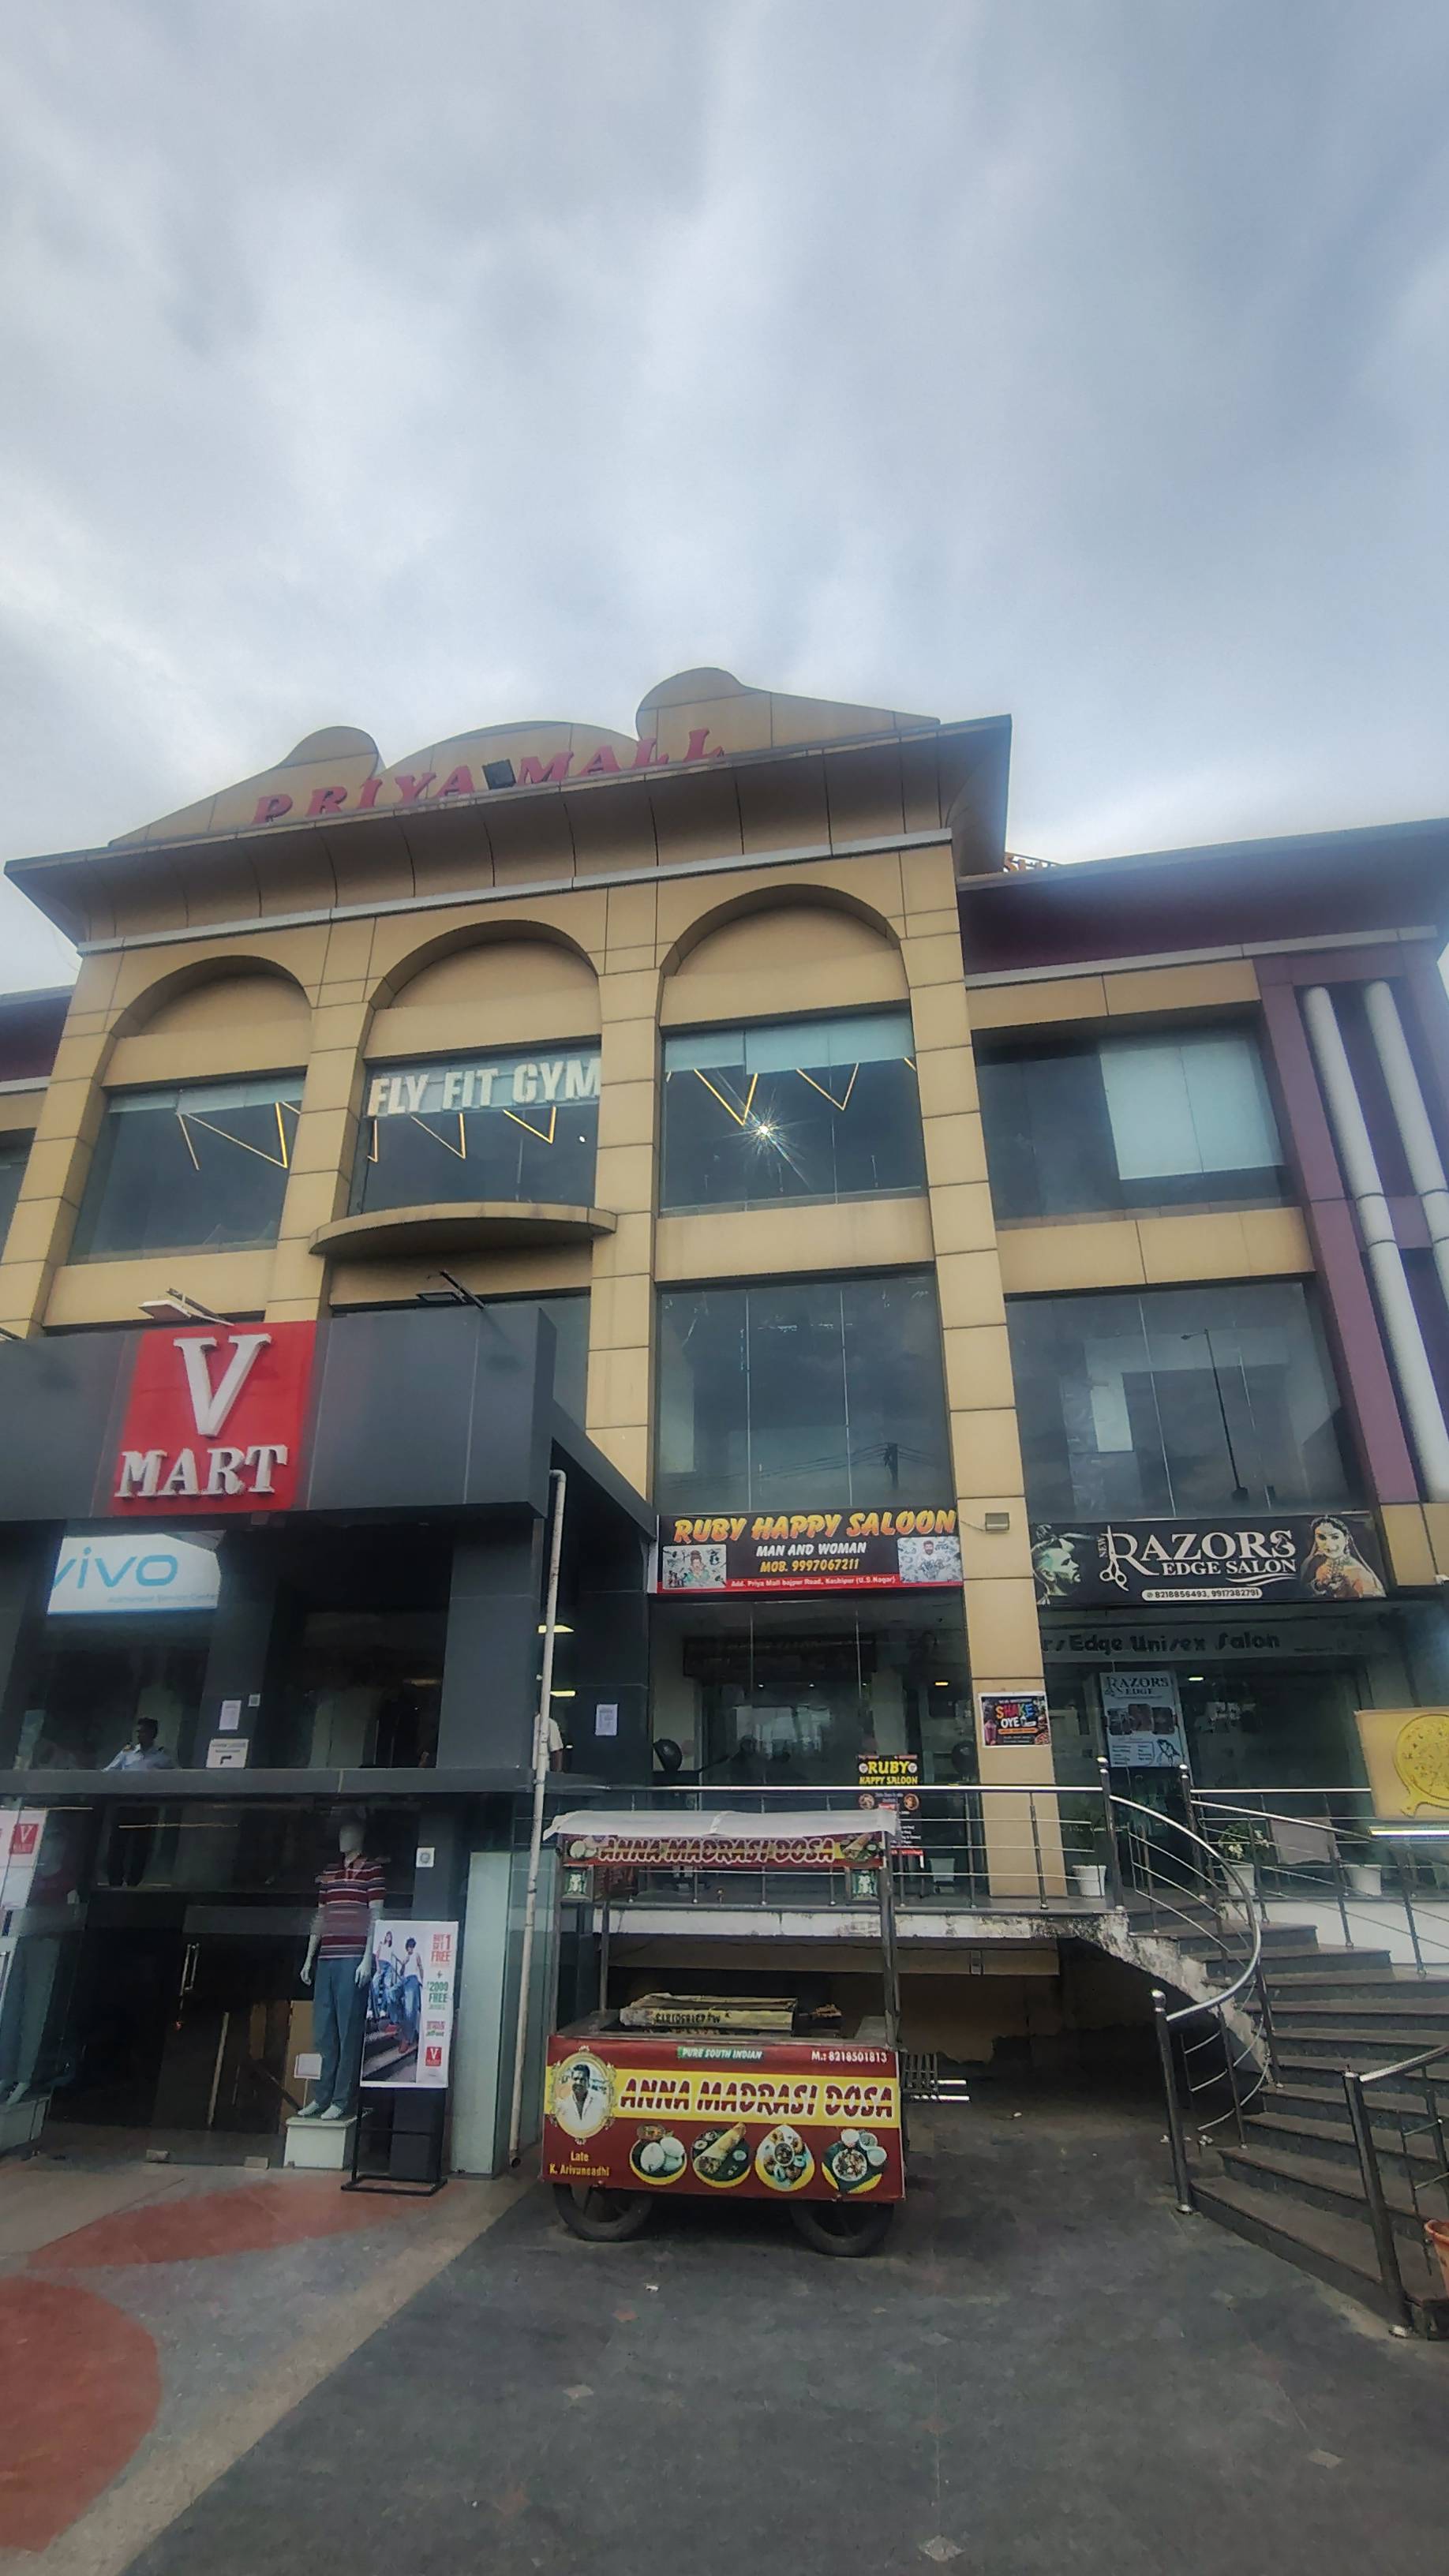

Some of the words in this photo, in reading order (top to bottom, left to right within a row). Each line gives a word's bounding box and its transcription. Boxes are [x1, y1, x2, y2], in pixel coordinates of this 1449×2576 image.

[251, 765, 475, 825] PRIYA
[515, 727, 725, 787] MALL
[368, 1073, 429, 1117] FLY
[442, 1069, 499, 1109] FIT
[513, 1058, 601, 1103] GYM
[174, 1333, 272, 1438] V
[114, 1444, 289, 1498] MART
[673, 1515, 747, 1544] RUBY
[751, 1513, 842, 1540] HAPPY
[846, 1509, 957, 1537] SALOON
[756, 1544, 784, 1557] MAN
[788, 1544, 814, 1556] AND
[818, 1541, 867, 1555] WOMAN
[1101, 1530, 1297, 1576] RAZORS
[52, 1546, 178, 1589] vivo
[760, 1559, 788, 1573] MOB.
[792, 1558, 860, 1572] 9997067211
[1162, 1561, 1221, 1576] EDGE
[1225, 1558, 1297, 1574] SALON
[747, 1579, 764, 1588] Priya
[1069, 1634, 1123, 1656] Edge
[1130, 1634, 1207, 1653] Unisex
[1216, 1632, 1280, 1650] Salon
[1105, 1676, 1169, 1694] RAZORS
[995, 1703, 1035, 1719] SHAKE
[867, 1761, 910, 1774] RUBY
[886, 1776, 919, 1784] SALOON
[599, 1837, 662, 1862] ANNA
[663, 1837, 769, 1863] MADRASI
[772, 1837, 836, 1863] DOSA
[682, 2047, 703, 2058] PURE
[704, 2048, 732, 2059] SOUTH
[732, 2050, 763, 2060] INDIAN
[620, 2078, 691, 2110] ANNA
[697, 2081, 818, 2116] MADRASI
[825, 2084, 893, 2118] DOSA
[571, 2151, 589, 2162] Late
